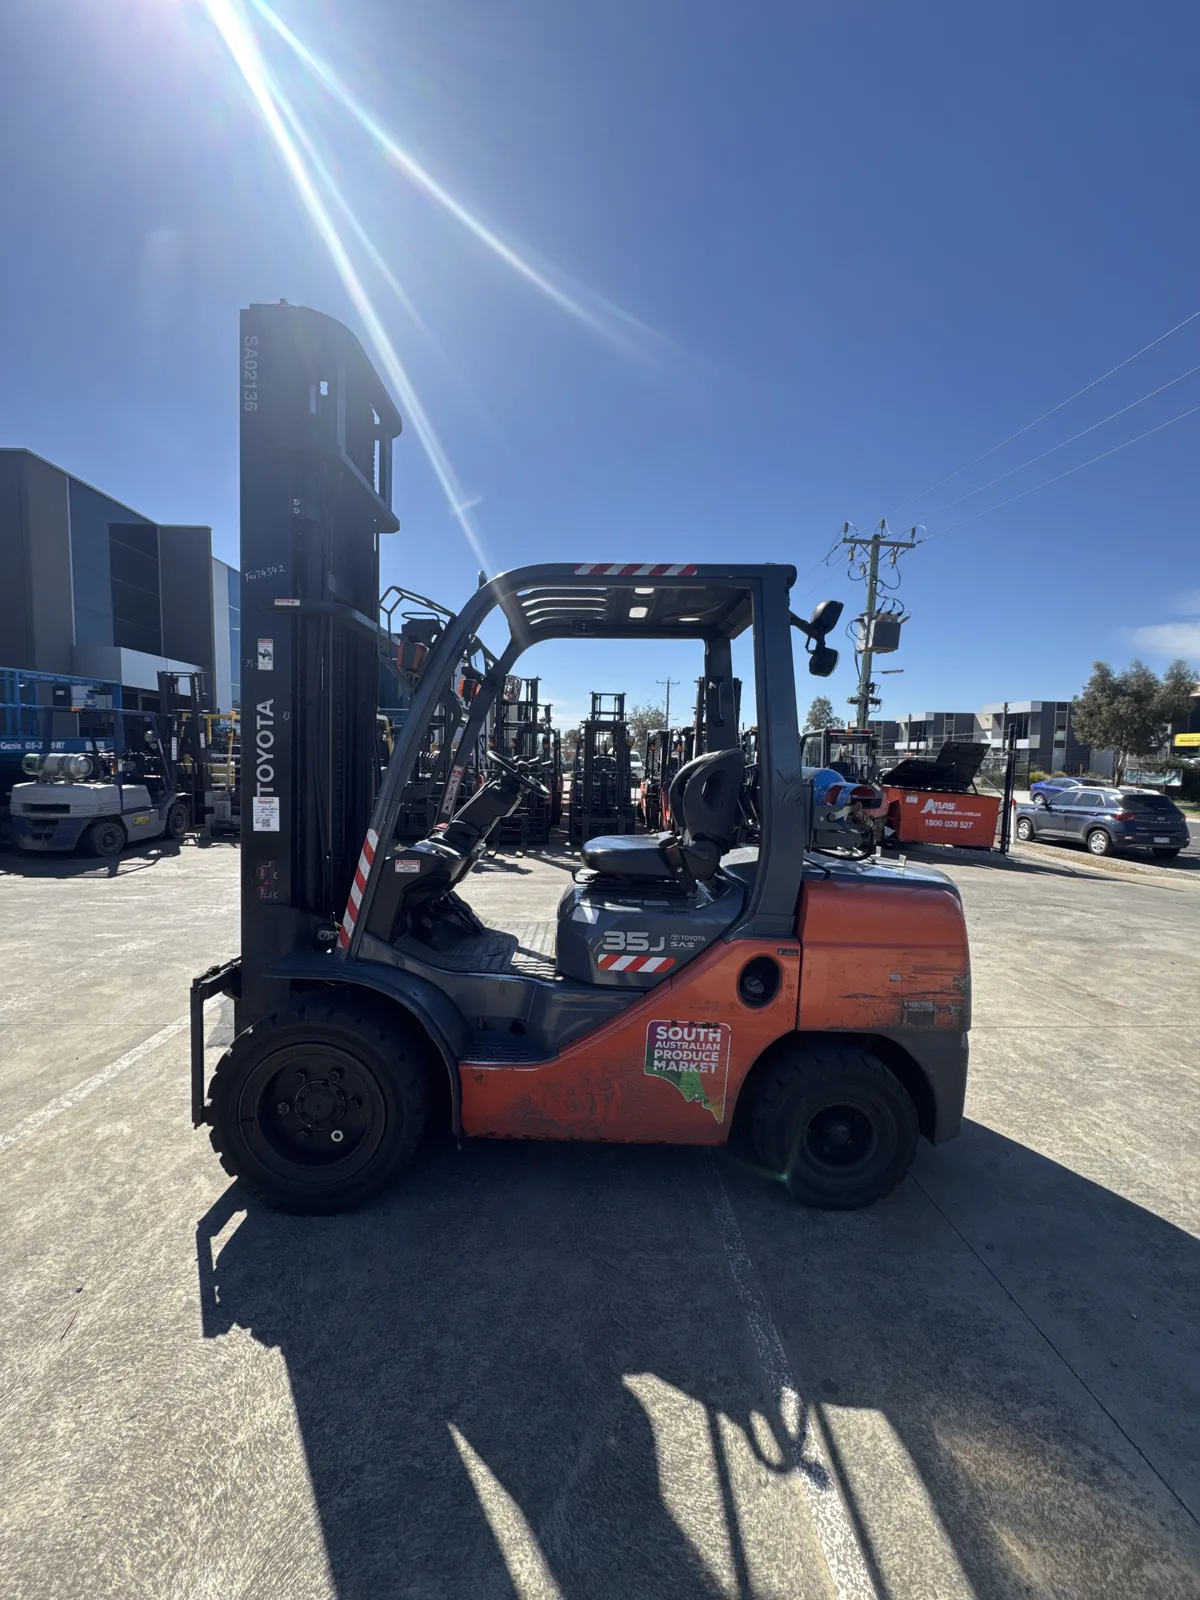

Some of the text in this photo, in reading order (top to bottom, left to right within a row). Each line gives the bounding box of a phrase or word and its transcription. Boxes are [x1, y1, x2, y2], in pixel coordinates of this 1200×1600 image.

[244, 335, 259, 412] SA02136
[0, 741, 22, 750] Genie
[256, 699, 274, 797] TOYOTA
[925, 819, 973, 829] 1800 028 527
[603, 930, 665, 952] 35J
[681, 934, 706, 942] TOYOTA
[656, 1026, 721, 1042] SOUTH
[655, 1041, 720, 1051] AUSTRALIAN
[654, 1050, 719, 1062] PRODUCE
[653, 1060, 718, 1074] MARKET
